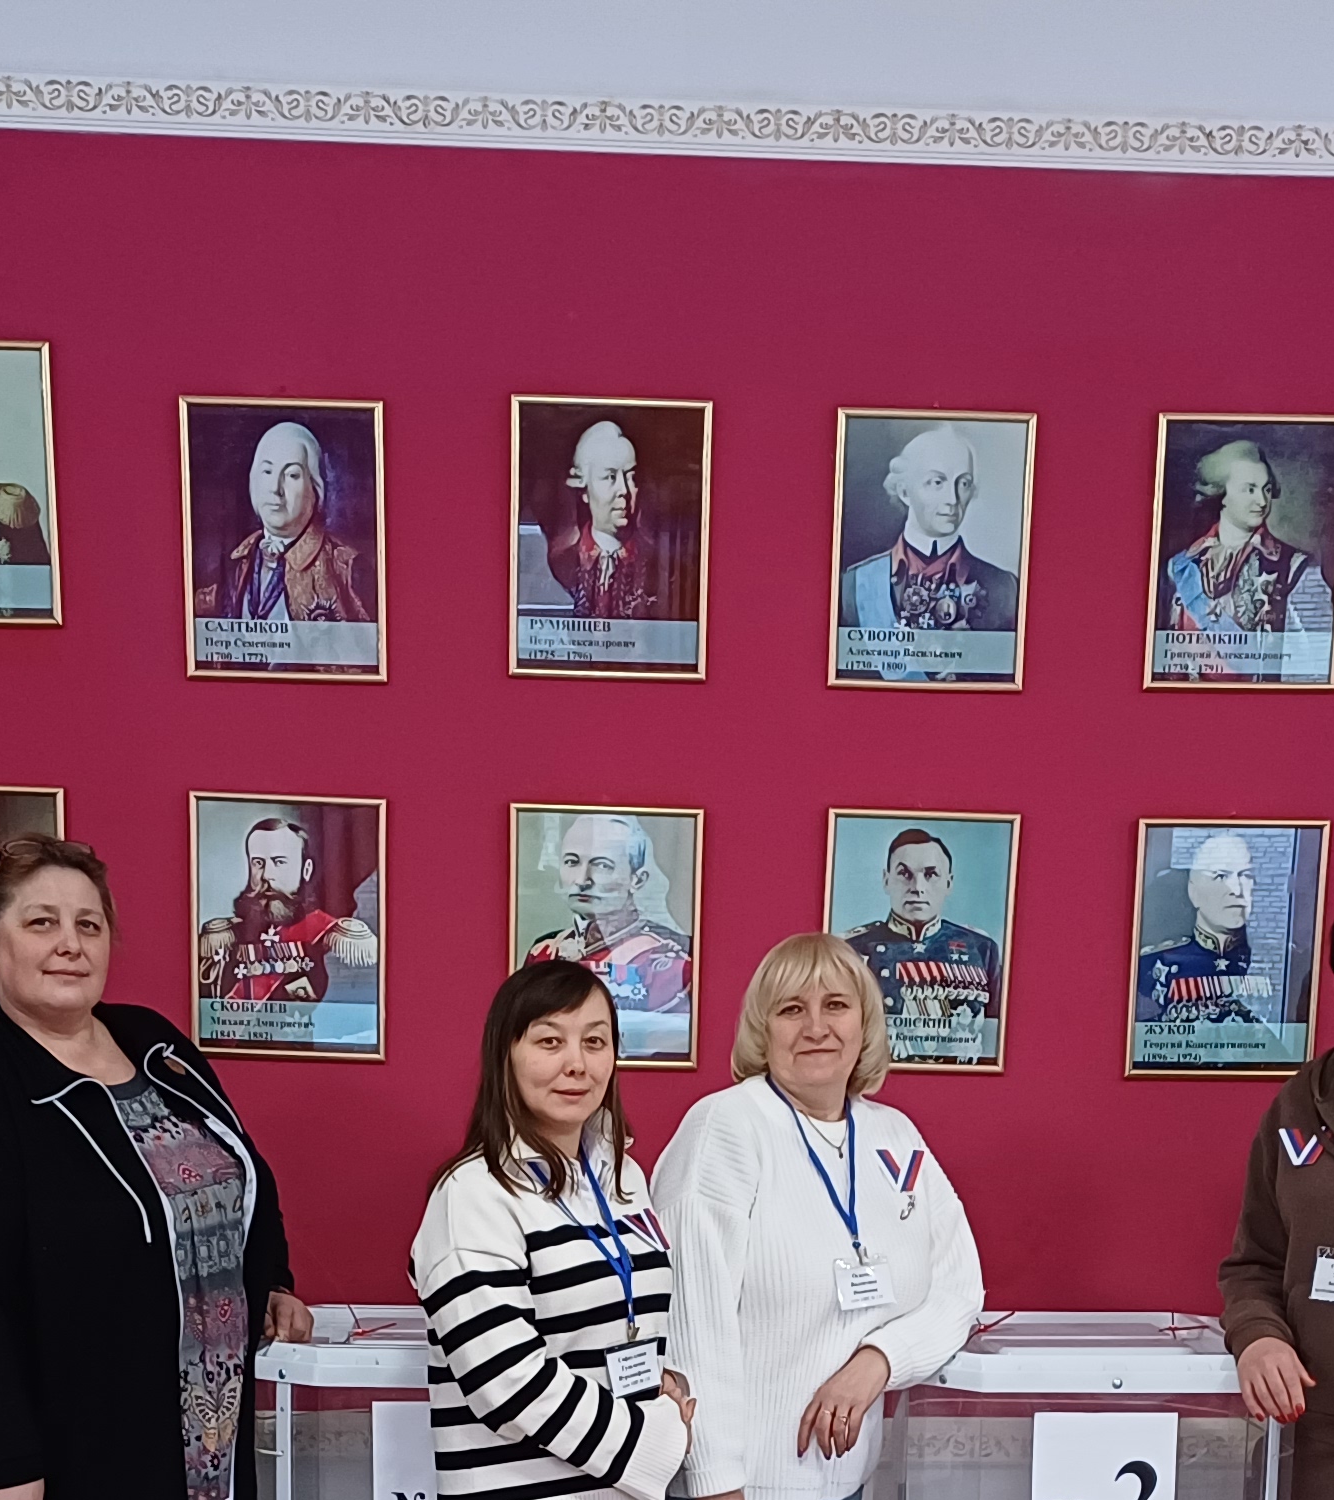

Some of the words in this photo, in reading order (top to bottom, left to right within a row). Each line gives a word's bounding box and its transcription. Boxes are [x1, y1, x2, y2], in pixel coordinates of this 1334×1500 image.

[204, 620, 289, 634] САЛТЫКОВ
[530, 619, 611, 633] РУМЯНЦЕВ
[847, 630, 916, 642] СУВОРОВ
[1165, 633, 1248, 645] ПОТЕМКИН
[205, 637, 231, 650] Петр
[234, 638, 291, 649] Семенович
[529, 636, 555, 647] Петр
[557, 637, 636, 649] Александрович
[846, 647, 901, 659] Александр
[903, 648, 963, 659] Васильевич
[1164, 649, 1212, 661] Григорий
[210, 1000, 287, 1014] СКОБЕЛЕВ
[210, 1016, 252, 1026] Михаил
[253, 1017, 316, 1029] Дмитриевич
[1144, 1024, 1196, 1035] ЖУКОВ
[1143, 1040, 1182, 1050] Георгий
[1185, 1040, 1266, 1050] Константинович
